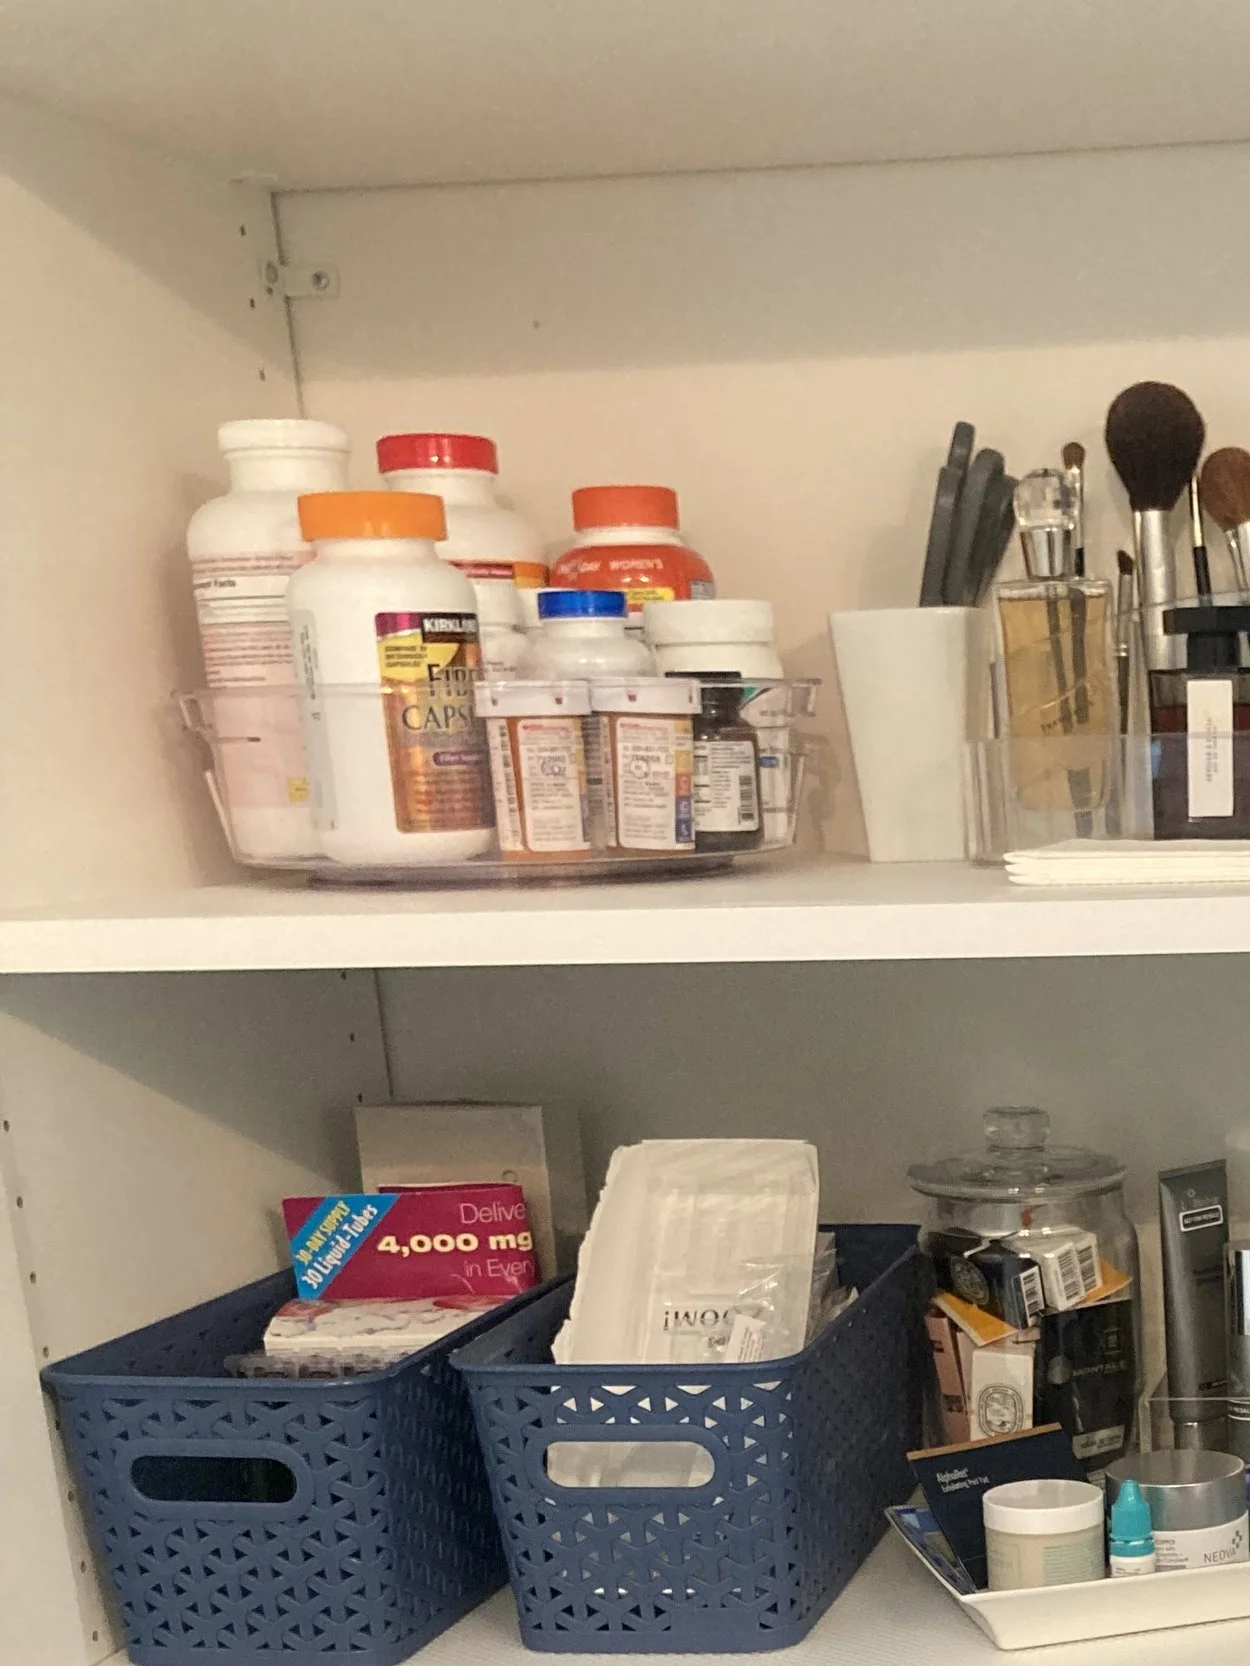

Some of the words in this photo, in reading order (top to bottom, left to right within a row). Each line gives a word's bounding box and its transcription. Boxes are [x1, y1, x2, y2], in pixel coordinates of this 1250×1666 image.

[460, 1201, 527, 1225] Delive
[377, 1232, 480, 1258] 4,000
[488, 1230, 533, 1252] mg
[464, 1260, 482, 1277] in
[1204, 1547, 1238, 1563] NEOVA
